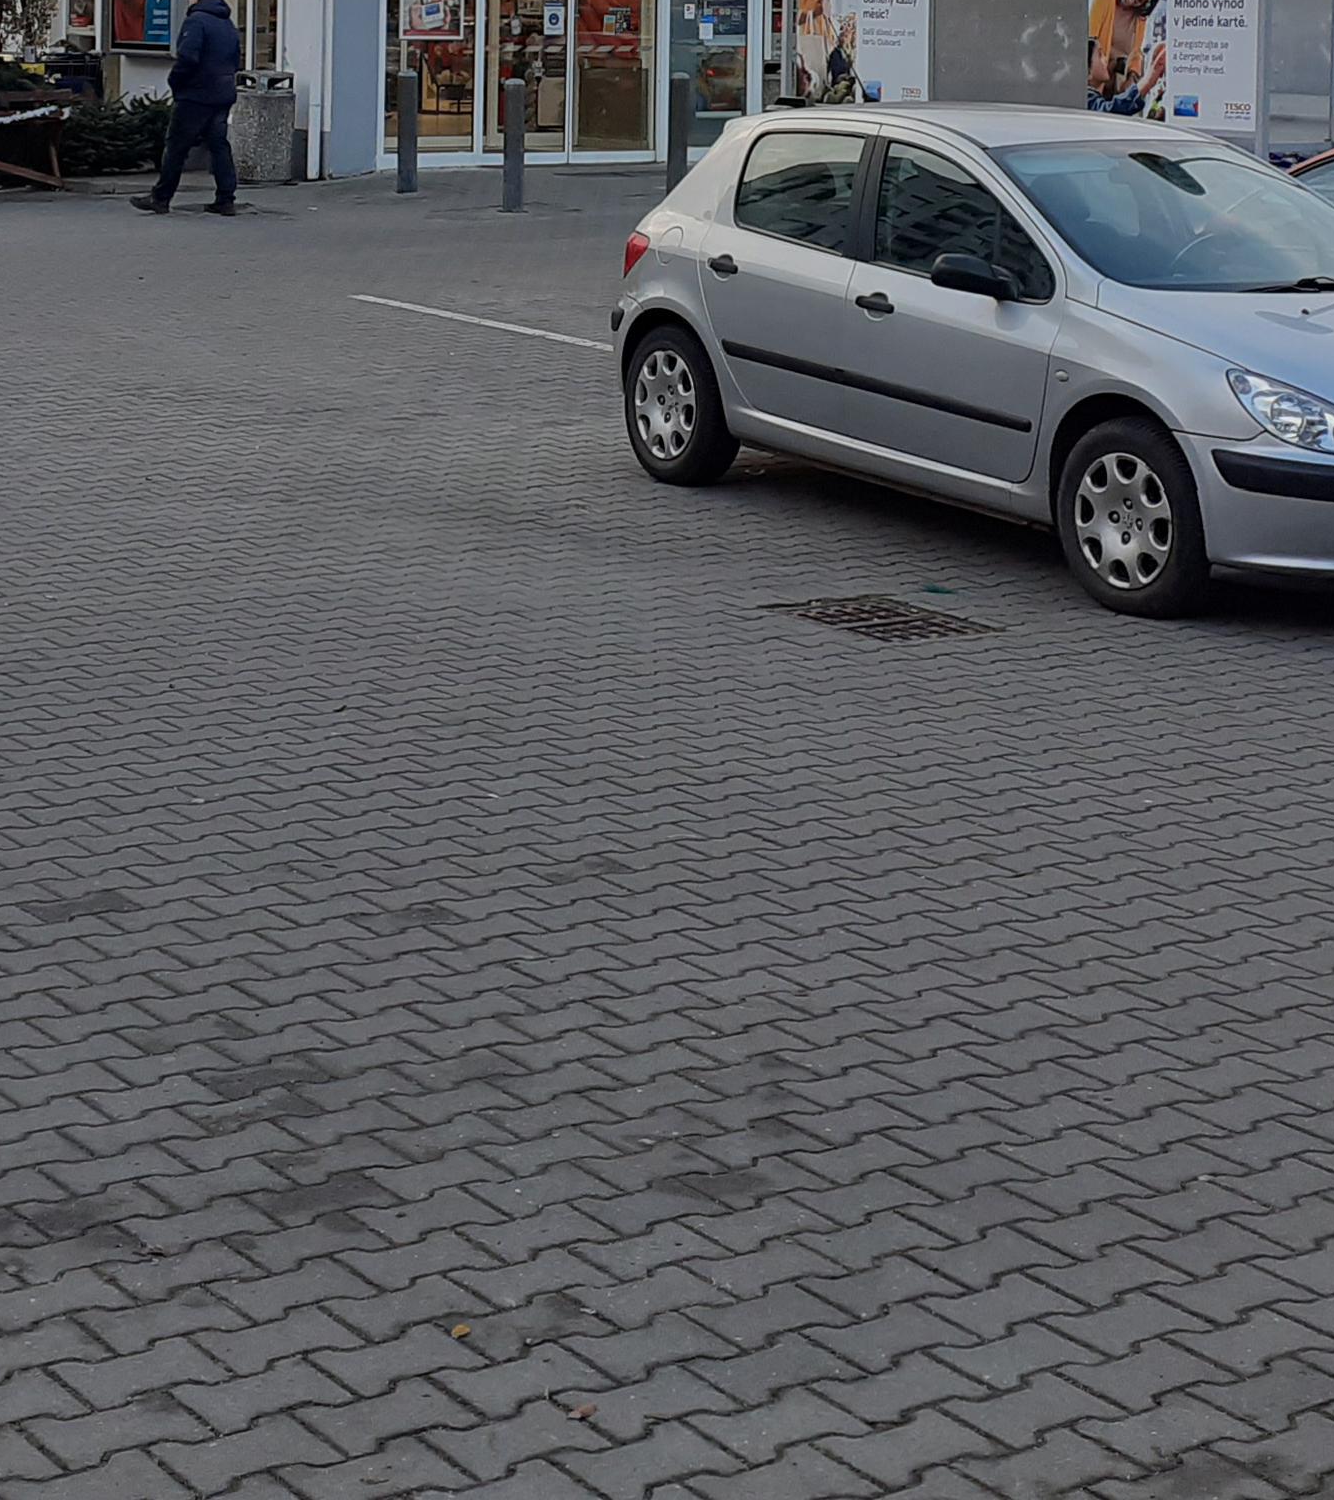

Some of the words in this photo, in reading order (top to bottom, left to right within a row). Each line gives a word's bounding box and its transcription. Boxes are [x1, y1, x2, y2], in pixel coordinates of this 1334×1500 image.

[1181, 14, 1214, 30] jediné
[1217, 14, 1248, 28] kartě.
[1224, 103, 1252, 111] TESCO
